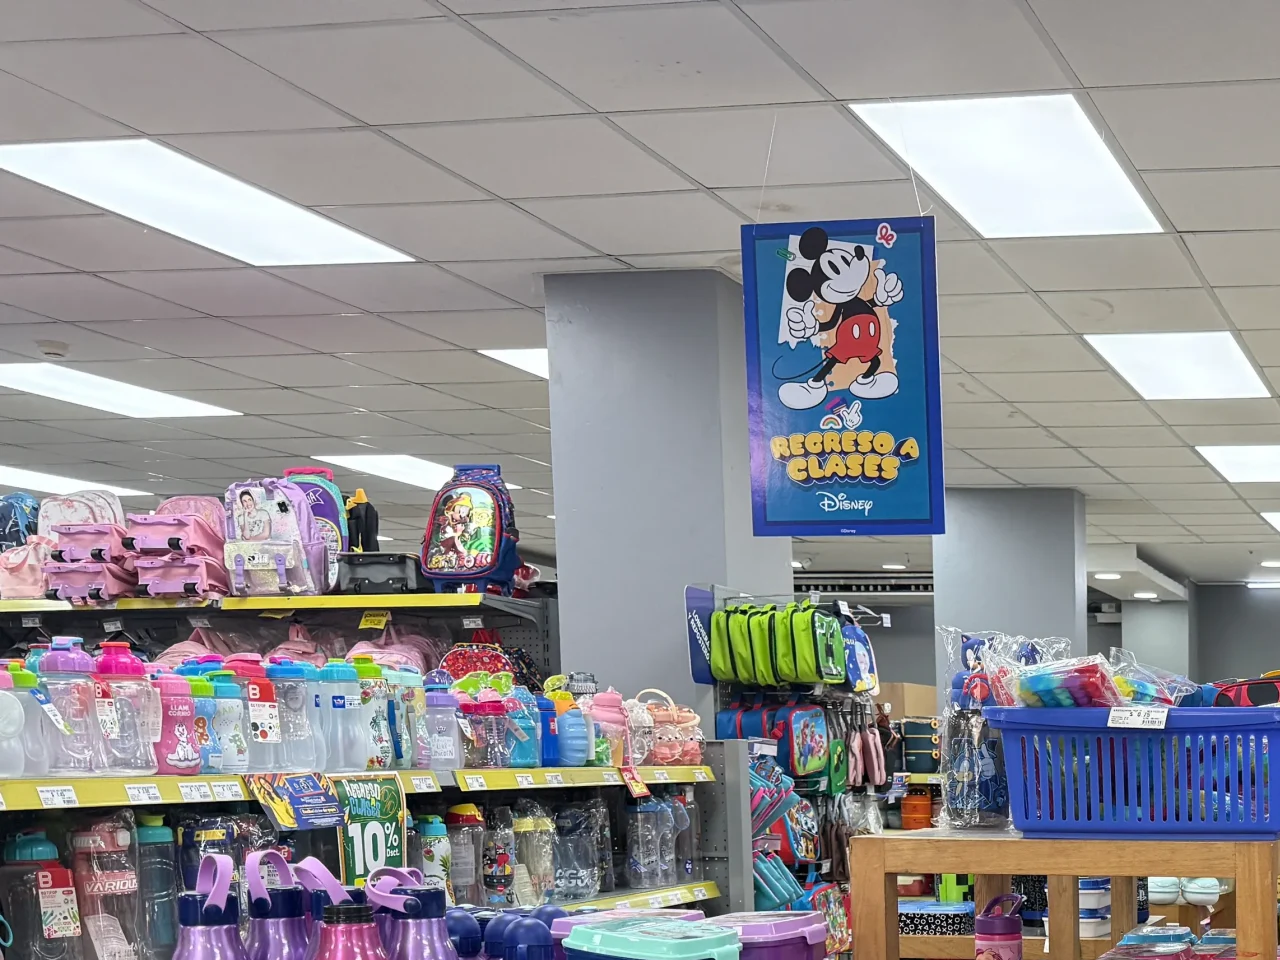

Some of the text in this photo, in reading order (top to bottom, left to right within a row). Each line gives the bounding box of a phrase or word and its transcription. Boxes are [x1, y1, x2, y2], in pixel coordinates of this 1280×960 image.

[770, 431, 920, 460] REGRESO A
[787, 455, 899, 482] CLASES
[815, 492, 873, 516] Disney
[249, 684, 260, 699] B
[349, 796, 381, 818] CLASES
[38, 871, 53, 888] B
